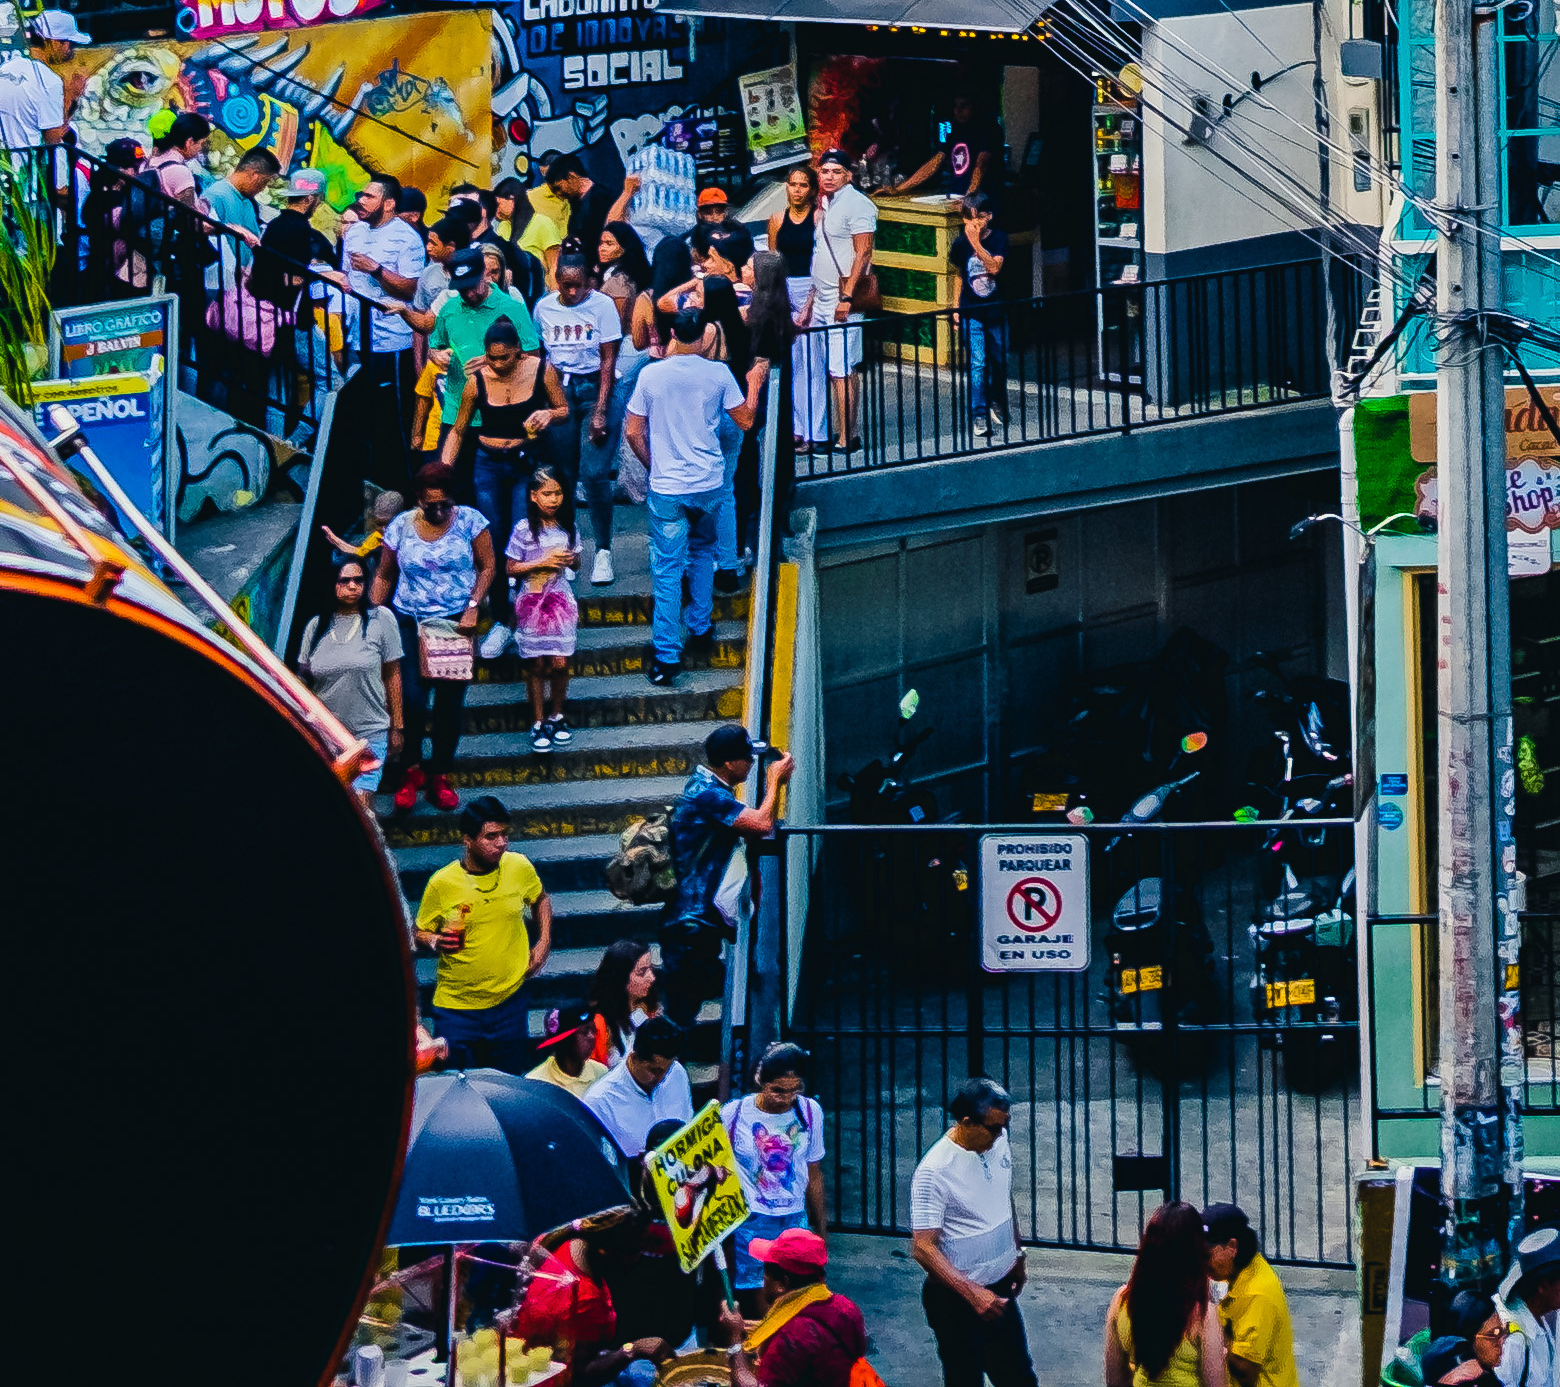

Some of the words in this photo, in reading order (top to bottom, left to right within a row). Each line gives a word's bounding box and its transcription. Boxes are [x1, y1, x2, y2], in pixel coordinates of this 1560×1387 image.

[563, 49, 683, 89] SOCIAL
[65, 319, 103, 339] LIBRO
[68, 395, 146, 423] PEÑOL
[997, 843, 1073, 855] PROHIBIDO
[999, 859, 1072, 872] PARQUEAR
[996, 935, 1074, 944] GARAJE
[999, 950, 1025, 960] EN
[1032, 949, 1071, 960] USO
